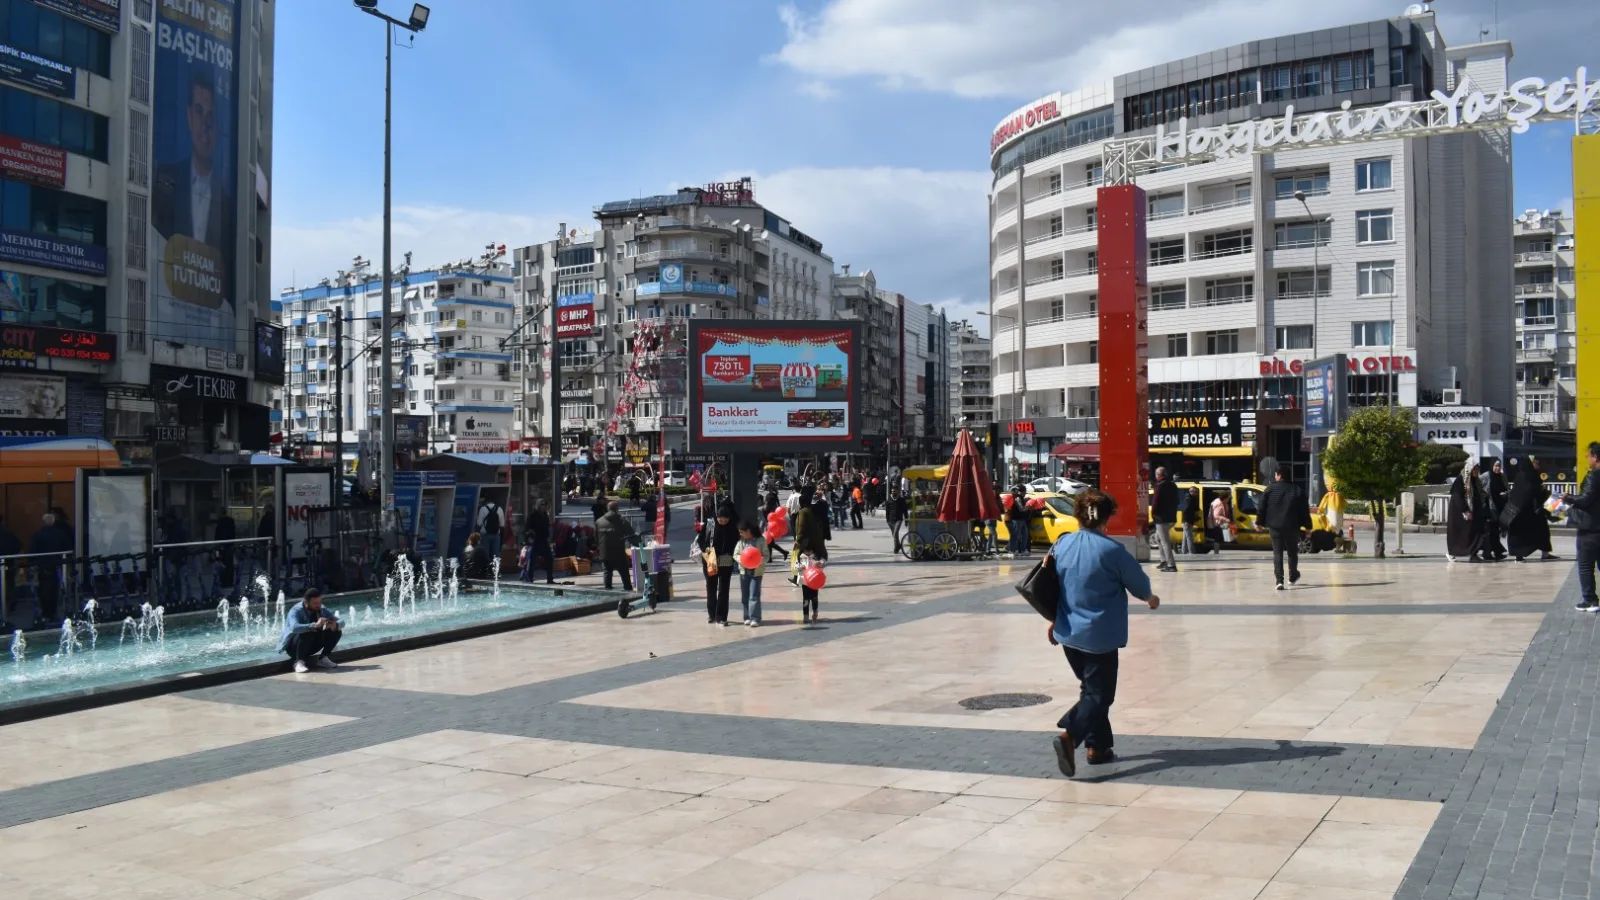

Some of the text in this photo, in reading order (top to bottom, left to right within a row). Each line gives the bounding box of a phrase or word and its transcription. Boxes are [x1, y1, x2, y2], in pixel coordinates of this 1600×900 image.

[208, 6, 232, 34] ÇAĞI
[158, 21, 233, 71] BAŞLIYOR
[20, 51, 72, 74] DANIŞMANLIK
[1025, 101, 1060, 127] OTEL
[21, 142, 62, 158] OYUNCULUK
[36, 155, 63, 168] AJANSI
[2, 158, 62, 180] ORGANİZASYON
[2, 234, 84, 262] MEHMET DEMİR
[183, 250, 214, 272] HAKAN
[569, 310, 588, 320] MHP
[557, 323, 591, 332] MURATPAŞA
[3, 328, 36, 350] CITY
[714, 362, 744, 371] 750 TL
[1259, 356, 1358, 375] BİLGN
[1363, 356, 1417, 374] OTEL
[707, 406, 759, 418] Bankkart
[1420, 410, 1482, 420] crispy corner
[1008, 421, 1034, 434] VSTEL
[1160, 416, 1209, 429] ANTALYA
[1182, 433, 1232, 445] BORSASI
[1427, 429, 1468, 440] pizza
